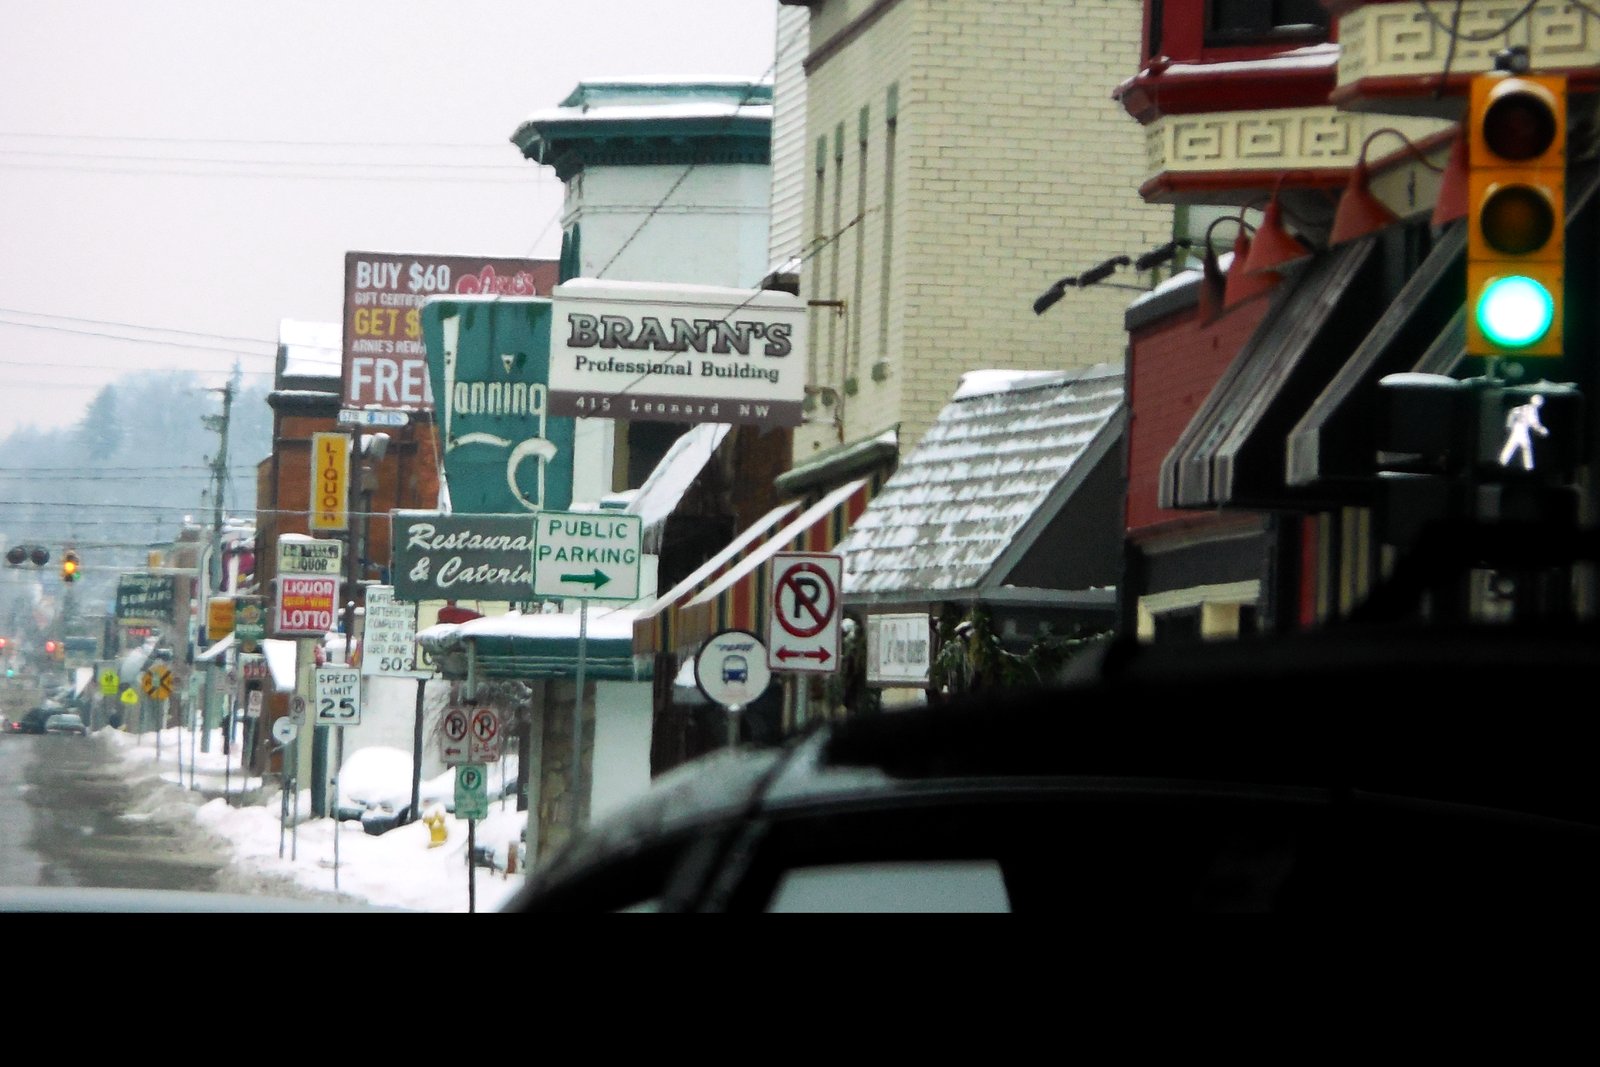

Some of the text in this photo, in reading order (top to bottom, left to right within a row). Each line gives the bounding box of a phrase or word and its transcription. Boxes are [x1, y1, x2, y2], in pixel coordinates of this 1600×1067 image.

[356, 261, 449, 292] BUY $60
[354, 307, 399, 336] GET
[567, 312, 792, 357] BRANN'S
[576, 355, 779, 383] Professional Building
[576, 396, 770, 416] 415 Leonard NW
[323, 442, 338, 521] LIQUOR
[549, 520, 627, 538] PUBLIC
[538, 545, 635, 565] PARKING
[409, 556, 431, 583] &
[284, 581, 333, 595] LIQUOR
[282, 609, 331, 628] LOTTO
[319, 673, 358, 684] SPEED
[322, 685, 353, 695] LIMIT
[320, 697, 356, 718] 25
